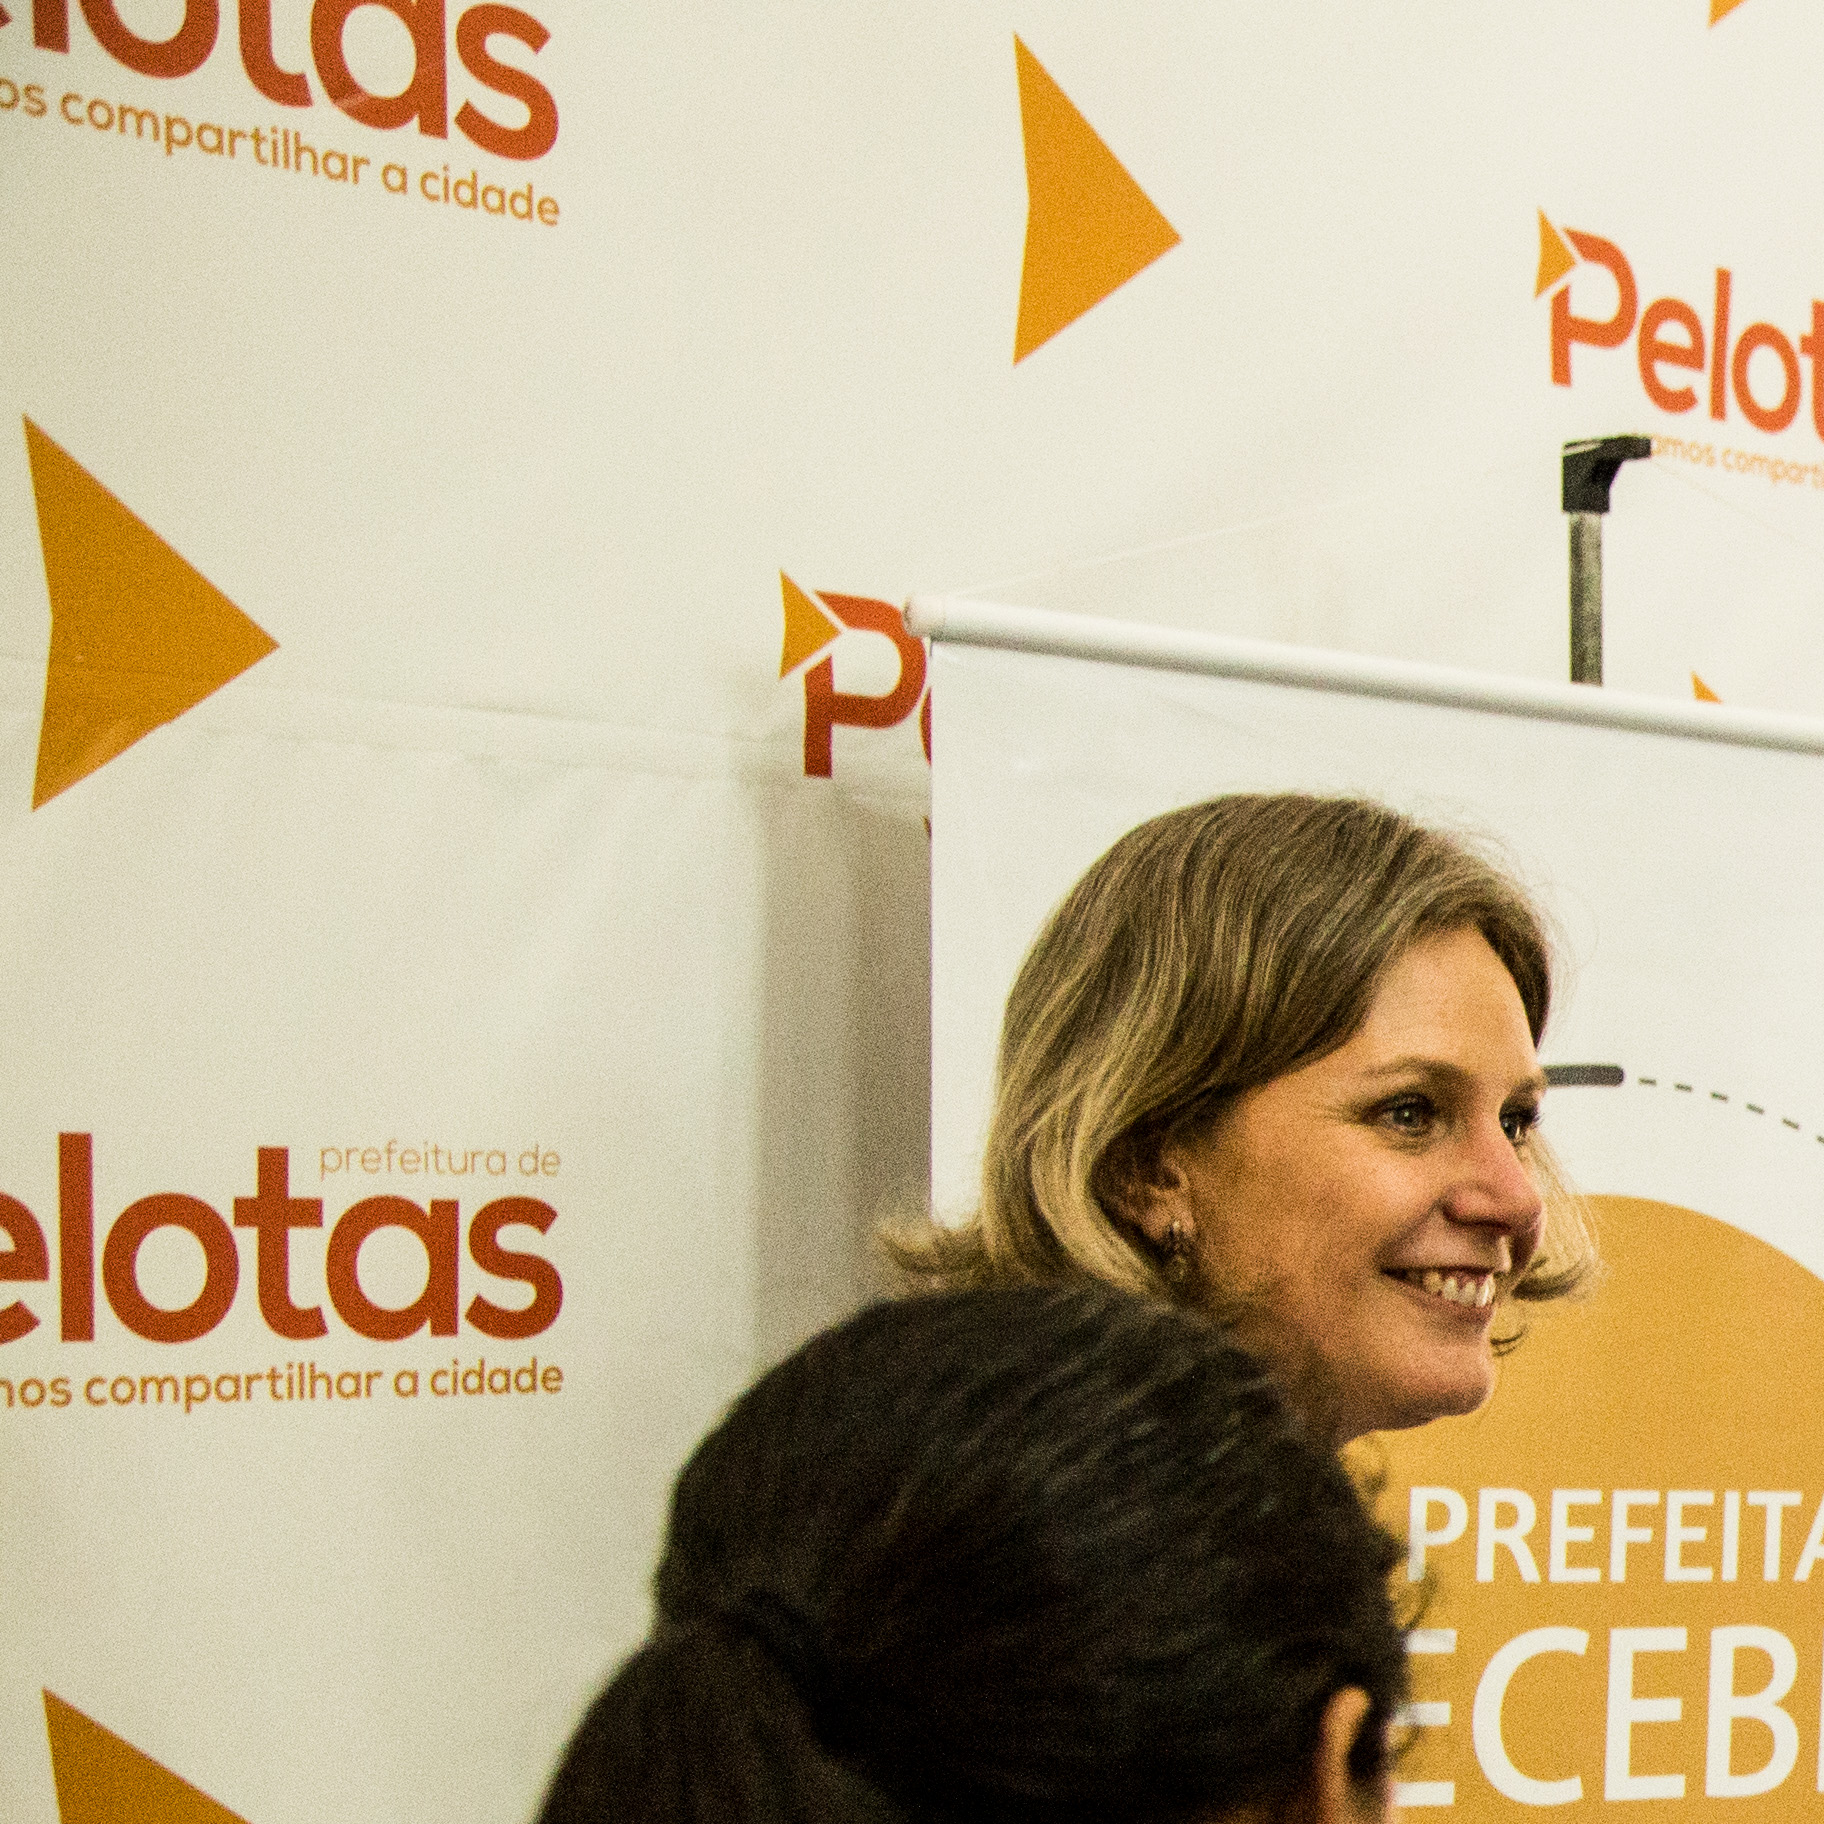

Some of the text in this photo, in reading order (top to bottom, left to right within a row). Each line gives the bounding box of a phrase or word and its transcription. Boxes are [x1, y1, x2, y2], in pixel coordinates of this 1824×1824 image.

[60, 90, 371, 186] compartilhar
[381, 162, 408, 194] a
[420, 163, 560, 227] cidade
[320, 1140, 562, 1181] prefeitura de
[85, 1361, 383, 1414] compartilhar
[393, 1369, 418, 1398] a
[430, 1356, 564, 1397] cidade
